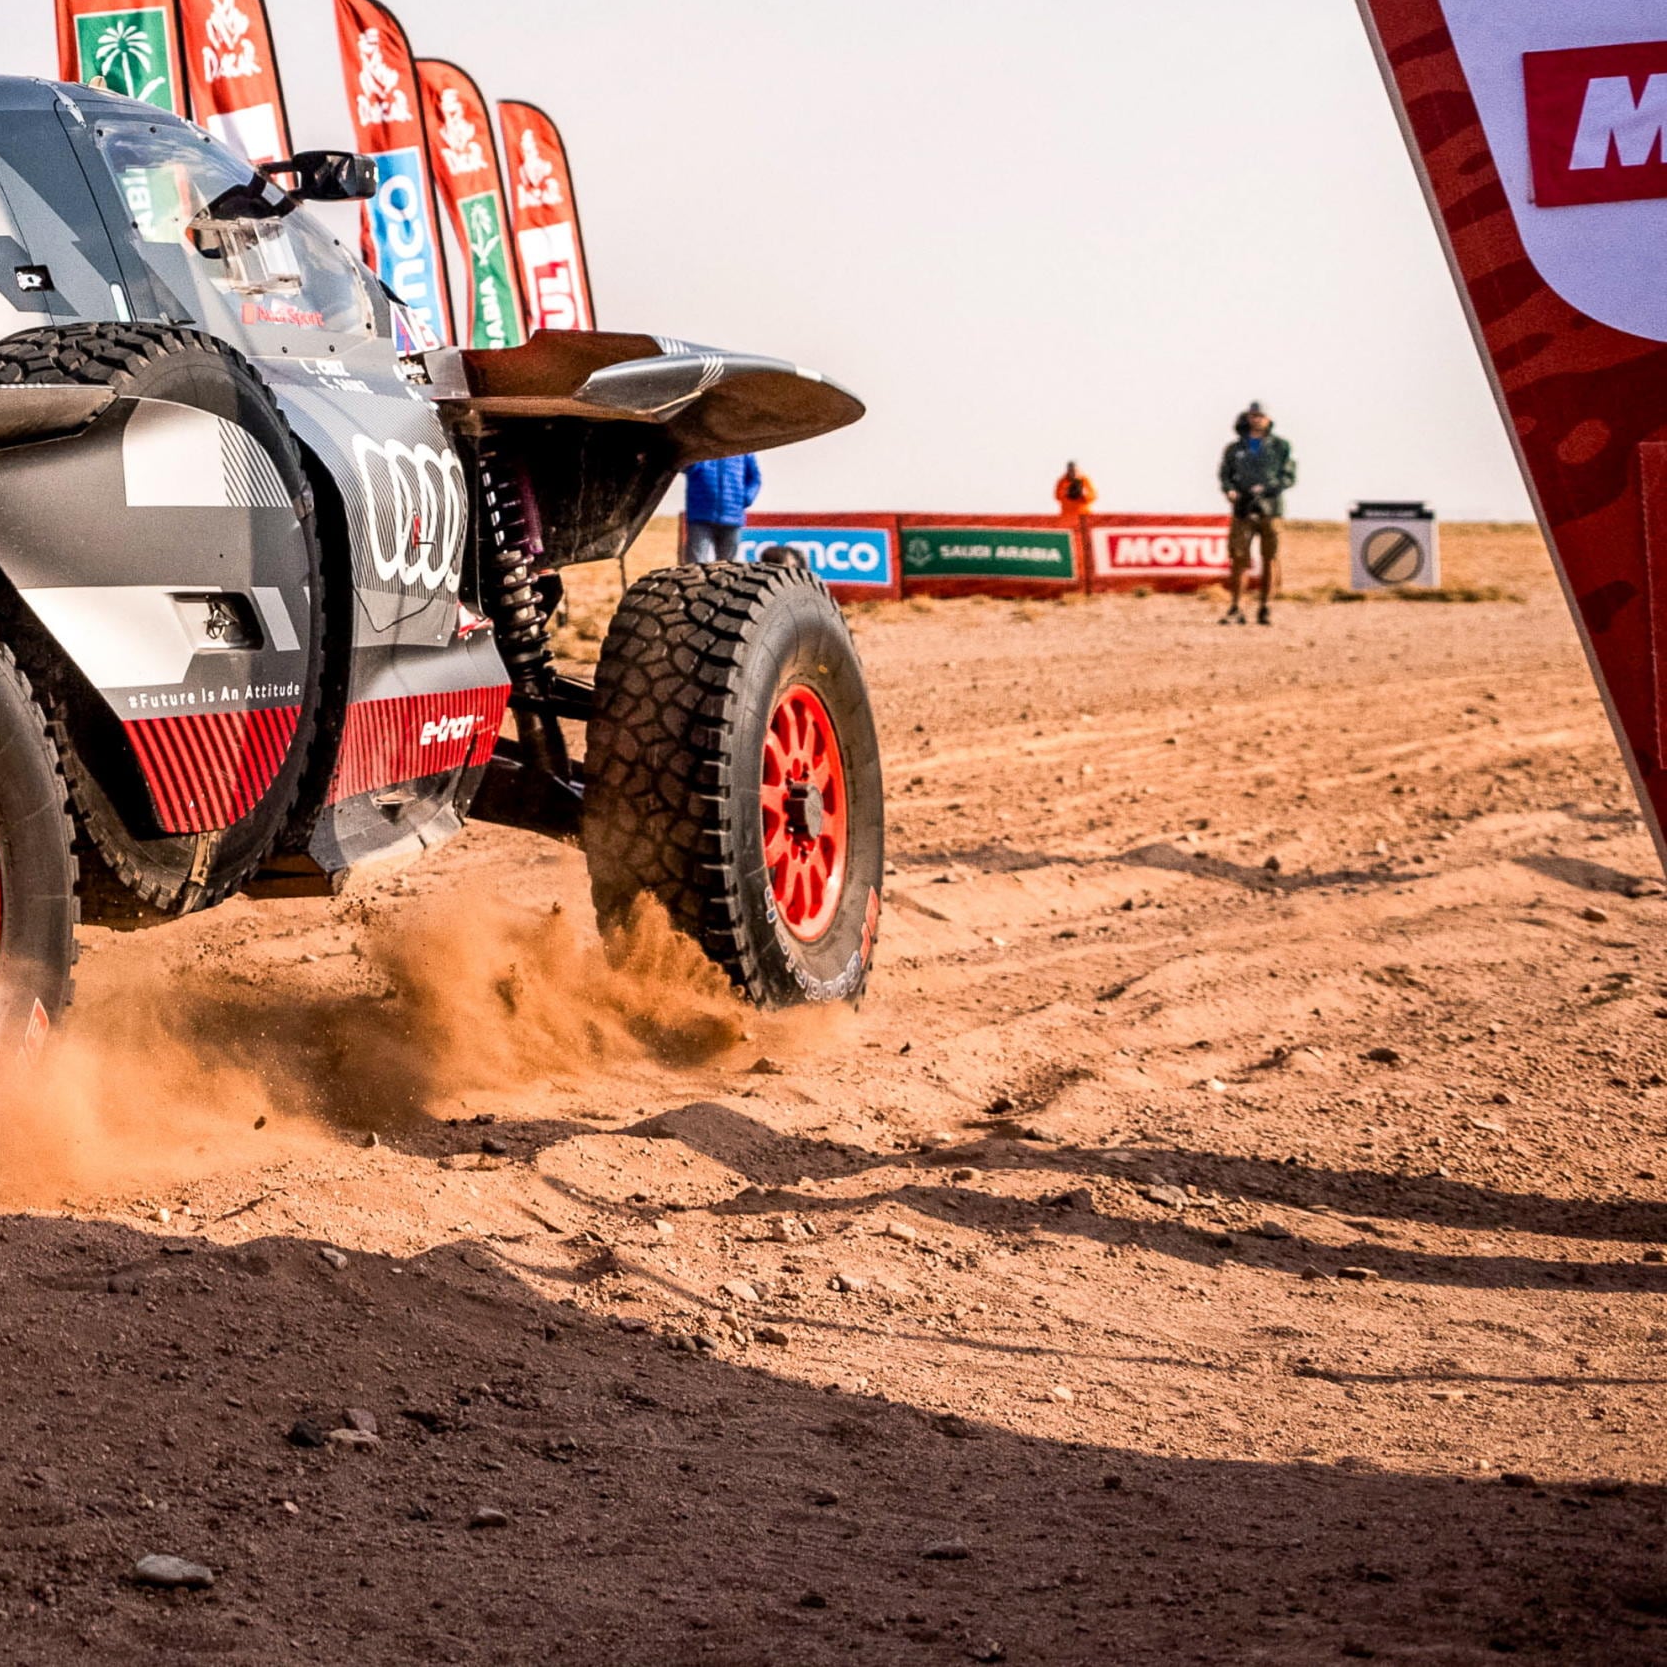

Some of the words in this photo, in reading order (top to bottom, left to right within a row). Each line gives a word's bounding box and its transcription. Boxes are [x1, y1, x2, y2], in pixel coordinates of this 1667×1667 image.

[939, 545, 991, 560] SAUDI
[995, 546, 1062, 562] ARABIA
[1116, 536, 1232, 566] MOTU
[128, 692, 196, 710] #Future
[201, 687, 215, 704] Is
[221, 685, 239, 702] An
[245, 681, 300, 700] Attitude
[420, 714, 474, 746] e-tron
